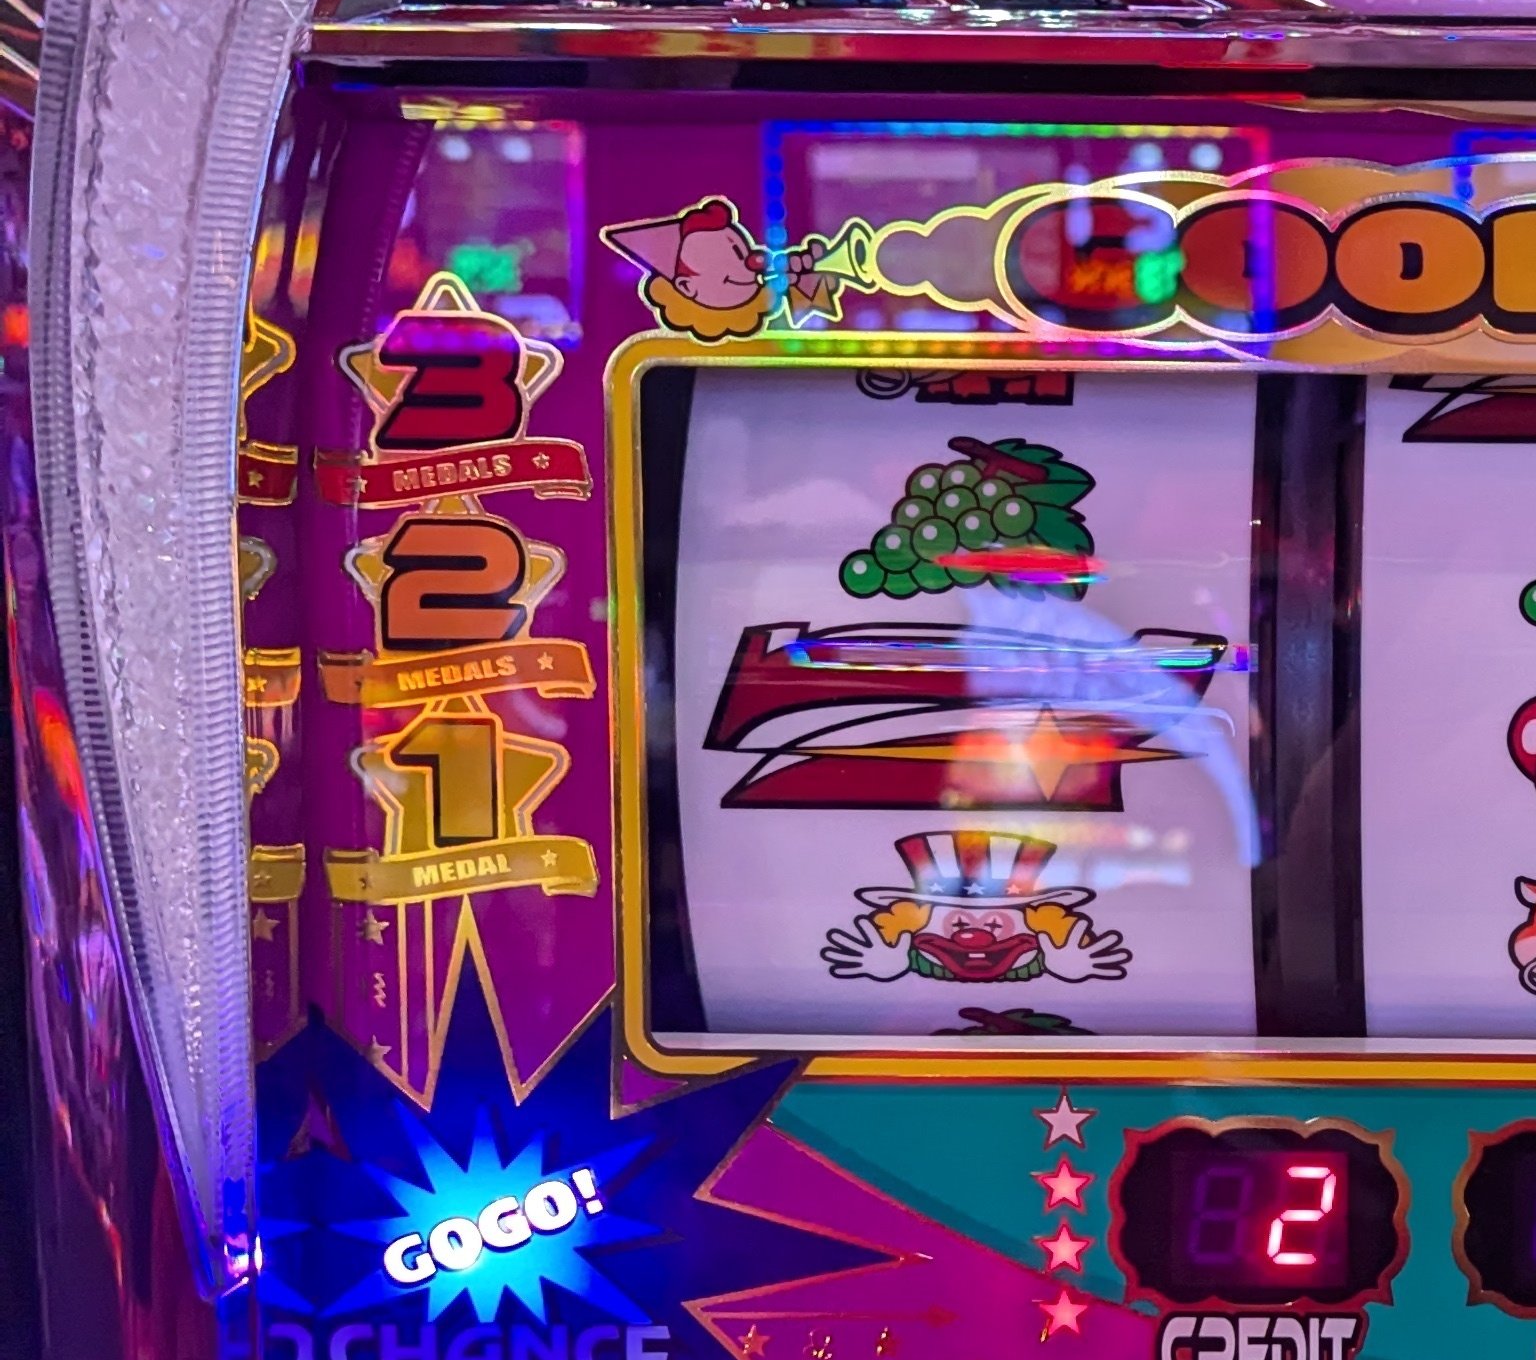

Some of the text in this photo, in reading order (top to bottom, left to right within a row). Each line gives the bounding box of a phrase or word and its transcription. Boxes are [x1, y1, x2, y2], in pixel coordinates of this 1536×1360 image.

[374, 314, 524, 450] 3
[392, 451, 513, 495] MEDALS
[379, 515, 528, 650] 2
[396, 654, 519, 693] MEDALS
[384, 711, 502, 847] 1
[410, 852, 513, 888] MEDAL
[381, 1166, 606, 1287] GOGO!
[1266, 1165, 1338, 1266] 2
